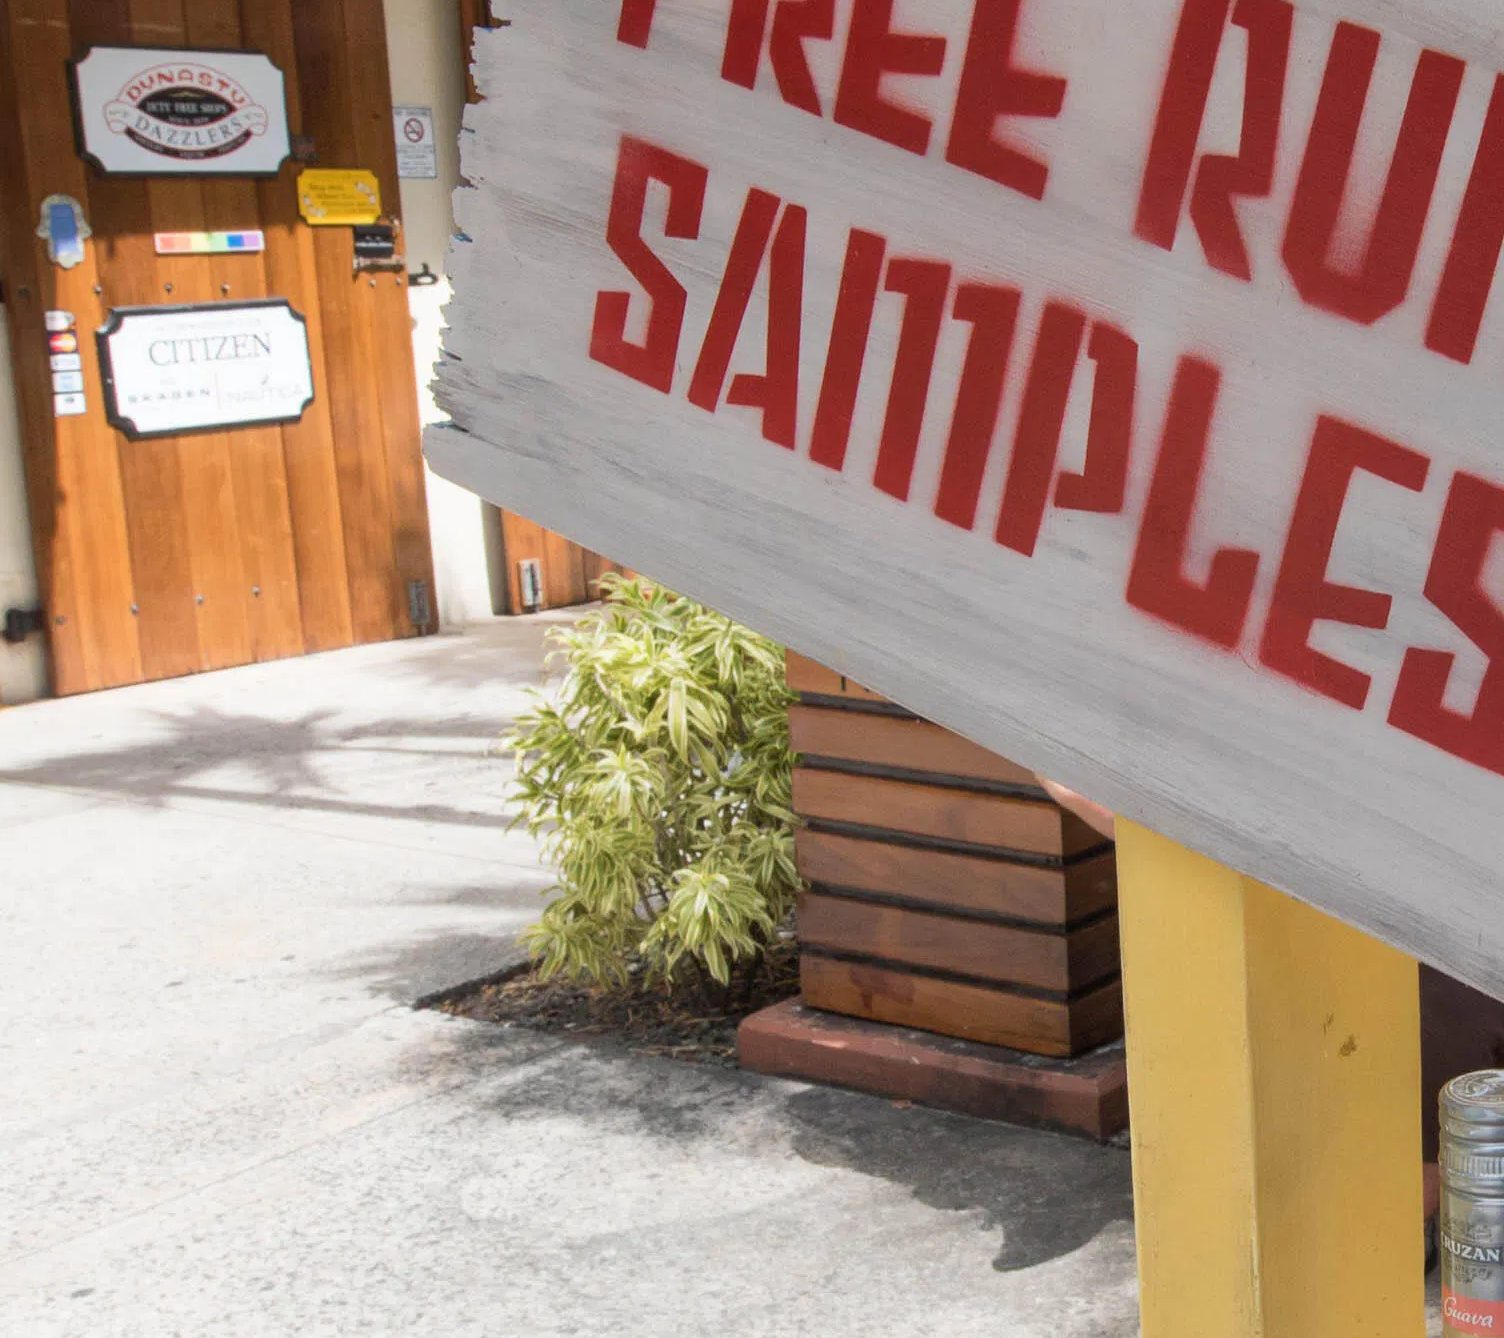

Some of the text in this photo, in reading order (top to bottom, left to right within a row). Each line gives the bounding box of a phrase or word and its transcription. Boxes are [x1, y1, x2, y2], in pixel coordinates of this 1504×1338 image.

[125, 68, 246, 105] DYNASTY
[134, 115, 243, 146] DAZZLERS
[148, 332, 272, 367] CITIZEN
[1442, 1294, 1495, 1329] Guava
